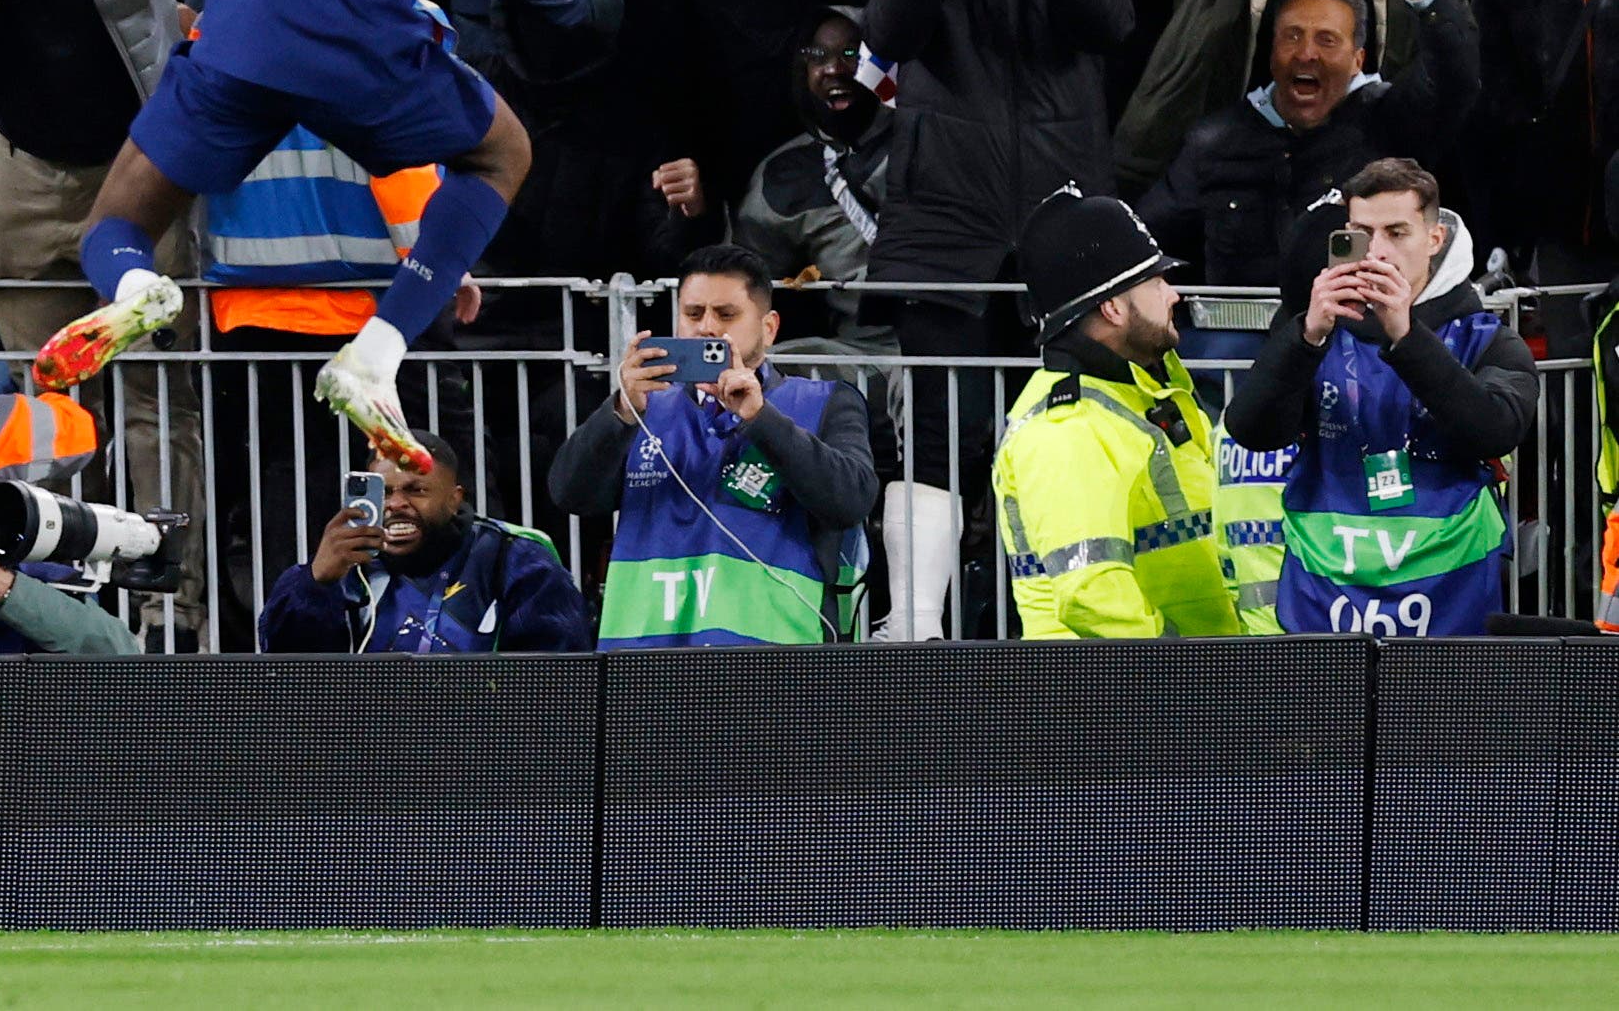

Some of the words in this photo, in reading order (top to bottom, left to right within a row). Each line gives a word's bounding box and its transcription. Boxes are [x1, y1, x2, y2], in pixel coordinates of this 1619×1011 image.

[1332, 525, 1417, 575] TV
[652, 566, 717, 621] TV
[1329, 593, 1432, 637] 069
